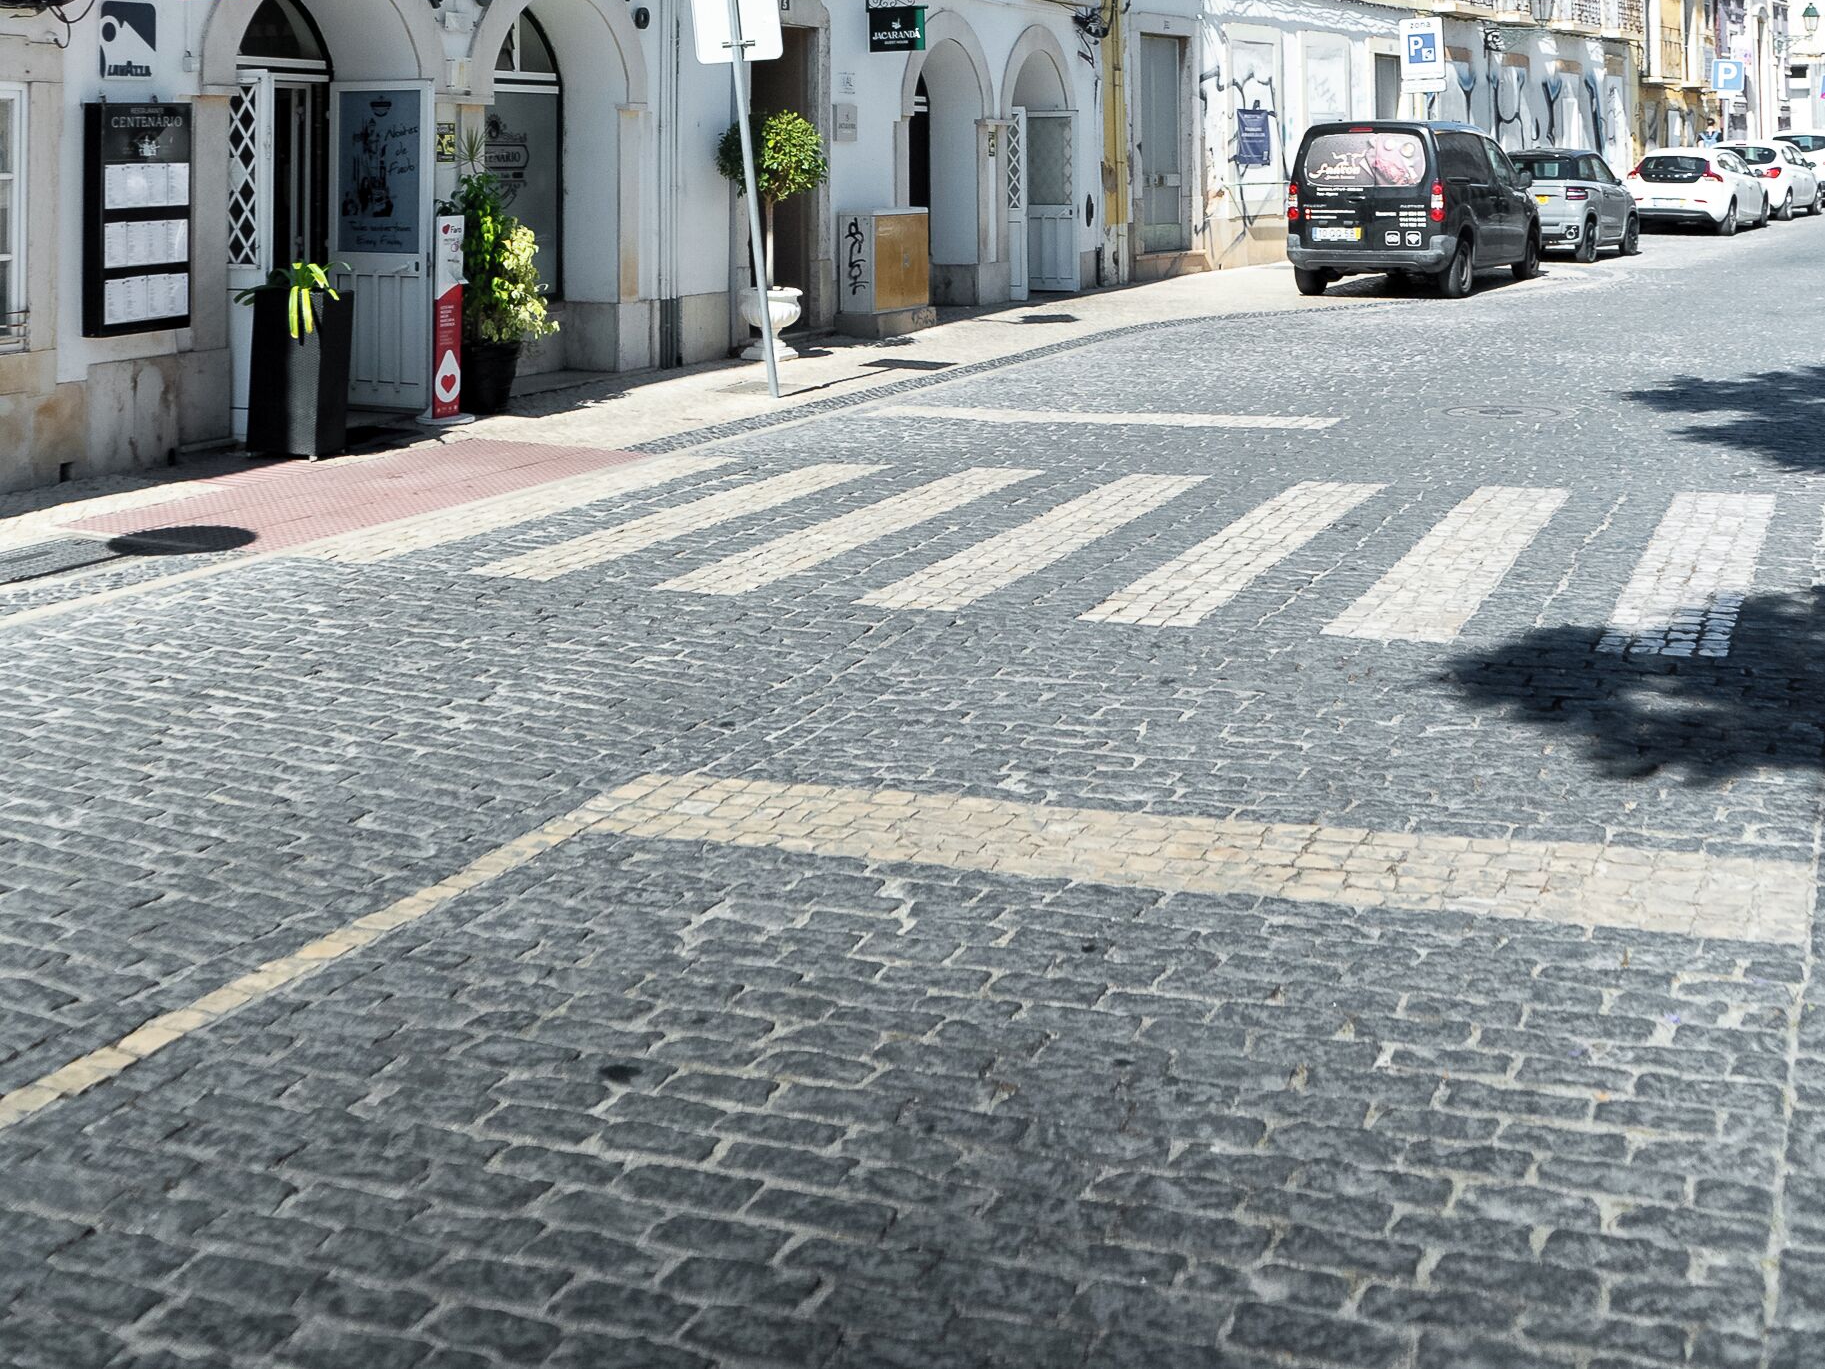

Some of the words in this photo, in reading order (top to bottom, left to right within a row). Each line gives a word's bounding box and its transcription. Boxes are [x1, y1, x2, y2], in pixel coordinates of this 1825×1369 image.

[872, 28, 921, 40] JACARANDÁ
[107, 60, 152, 77] LAVAZZA
[1717, 62, 1738, 88] P
